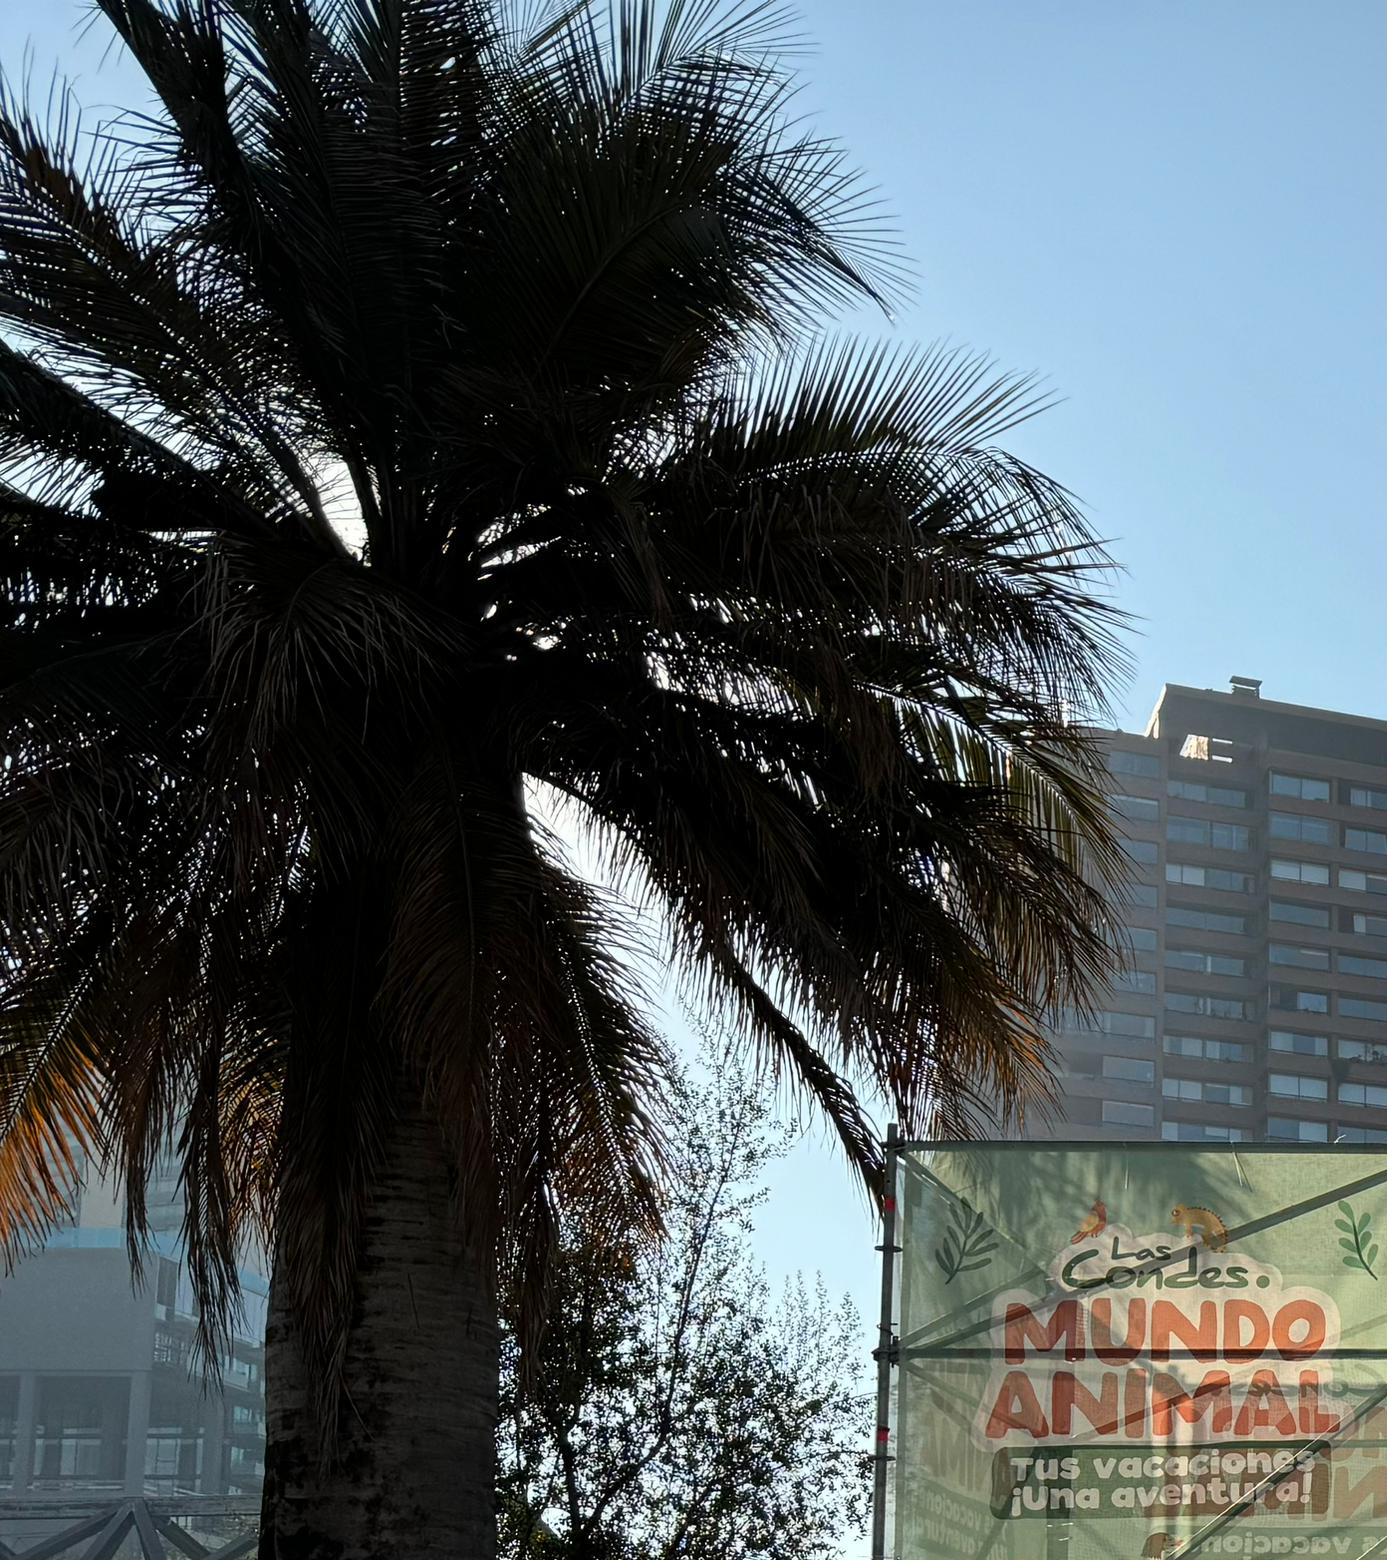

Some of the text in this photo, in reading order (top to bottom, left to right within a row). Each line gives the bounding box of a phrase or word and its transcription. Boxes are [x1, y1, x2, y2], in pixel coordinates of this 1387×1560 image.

[1111, 1237, 1171, 1261] Las
[1004, 1297, 1326, 1366] MUNDO
[985, 1368, 1341, 1438] ANIMAL
[1010, 1448, 1316, 1482] Tus vacaciones
[1011, 1485, 1100, 1517] ¡Una
[1111, 1472, 1311, 1508] aventura!
